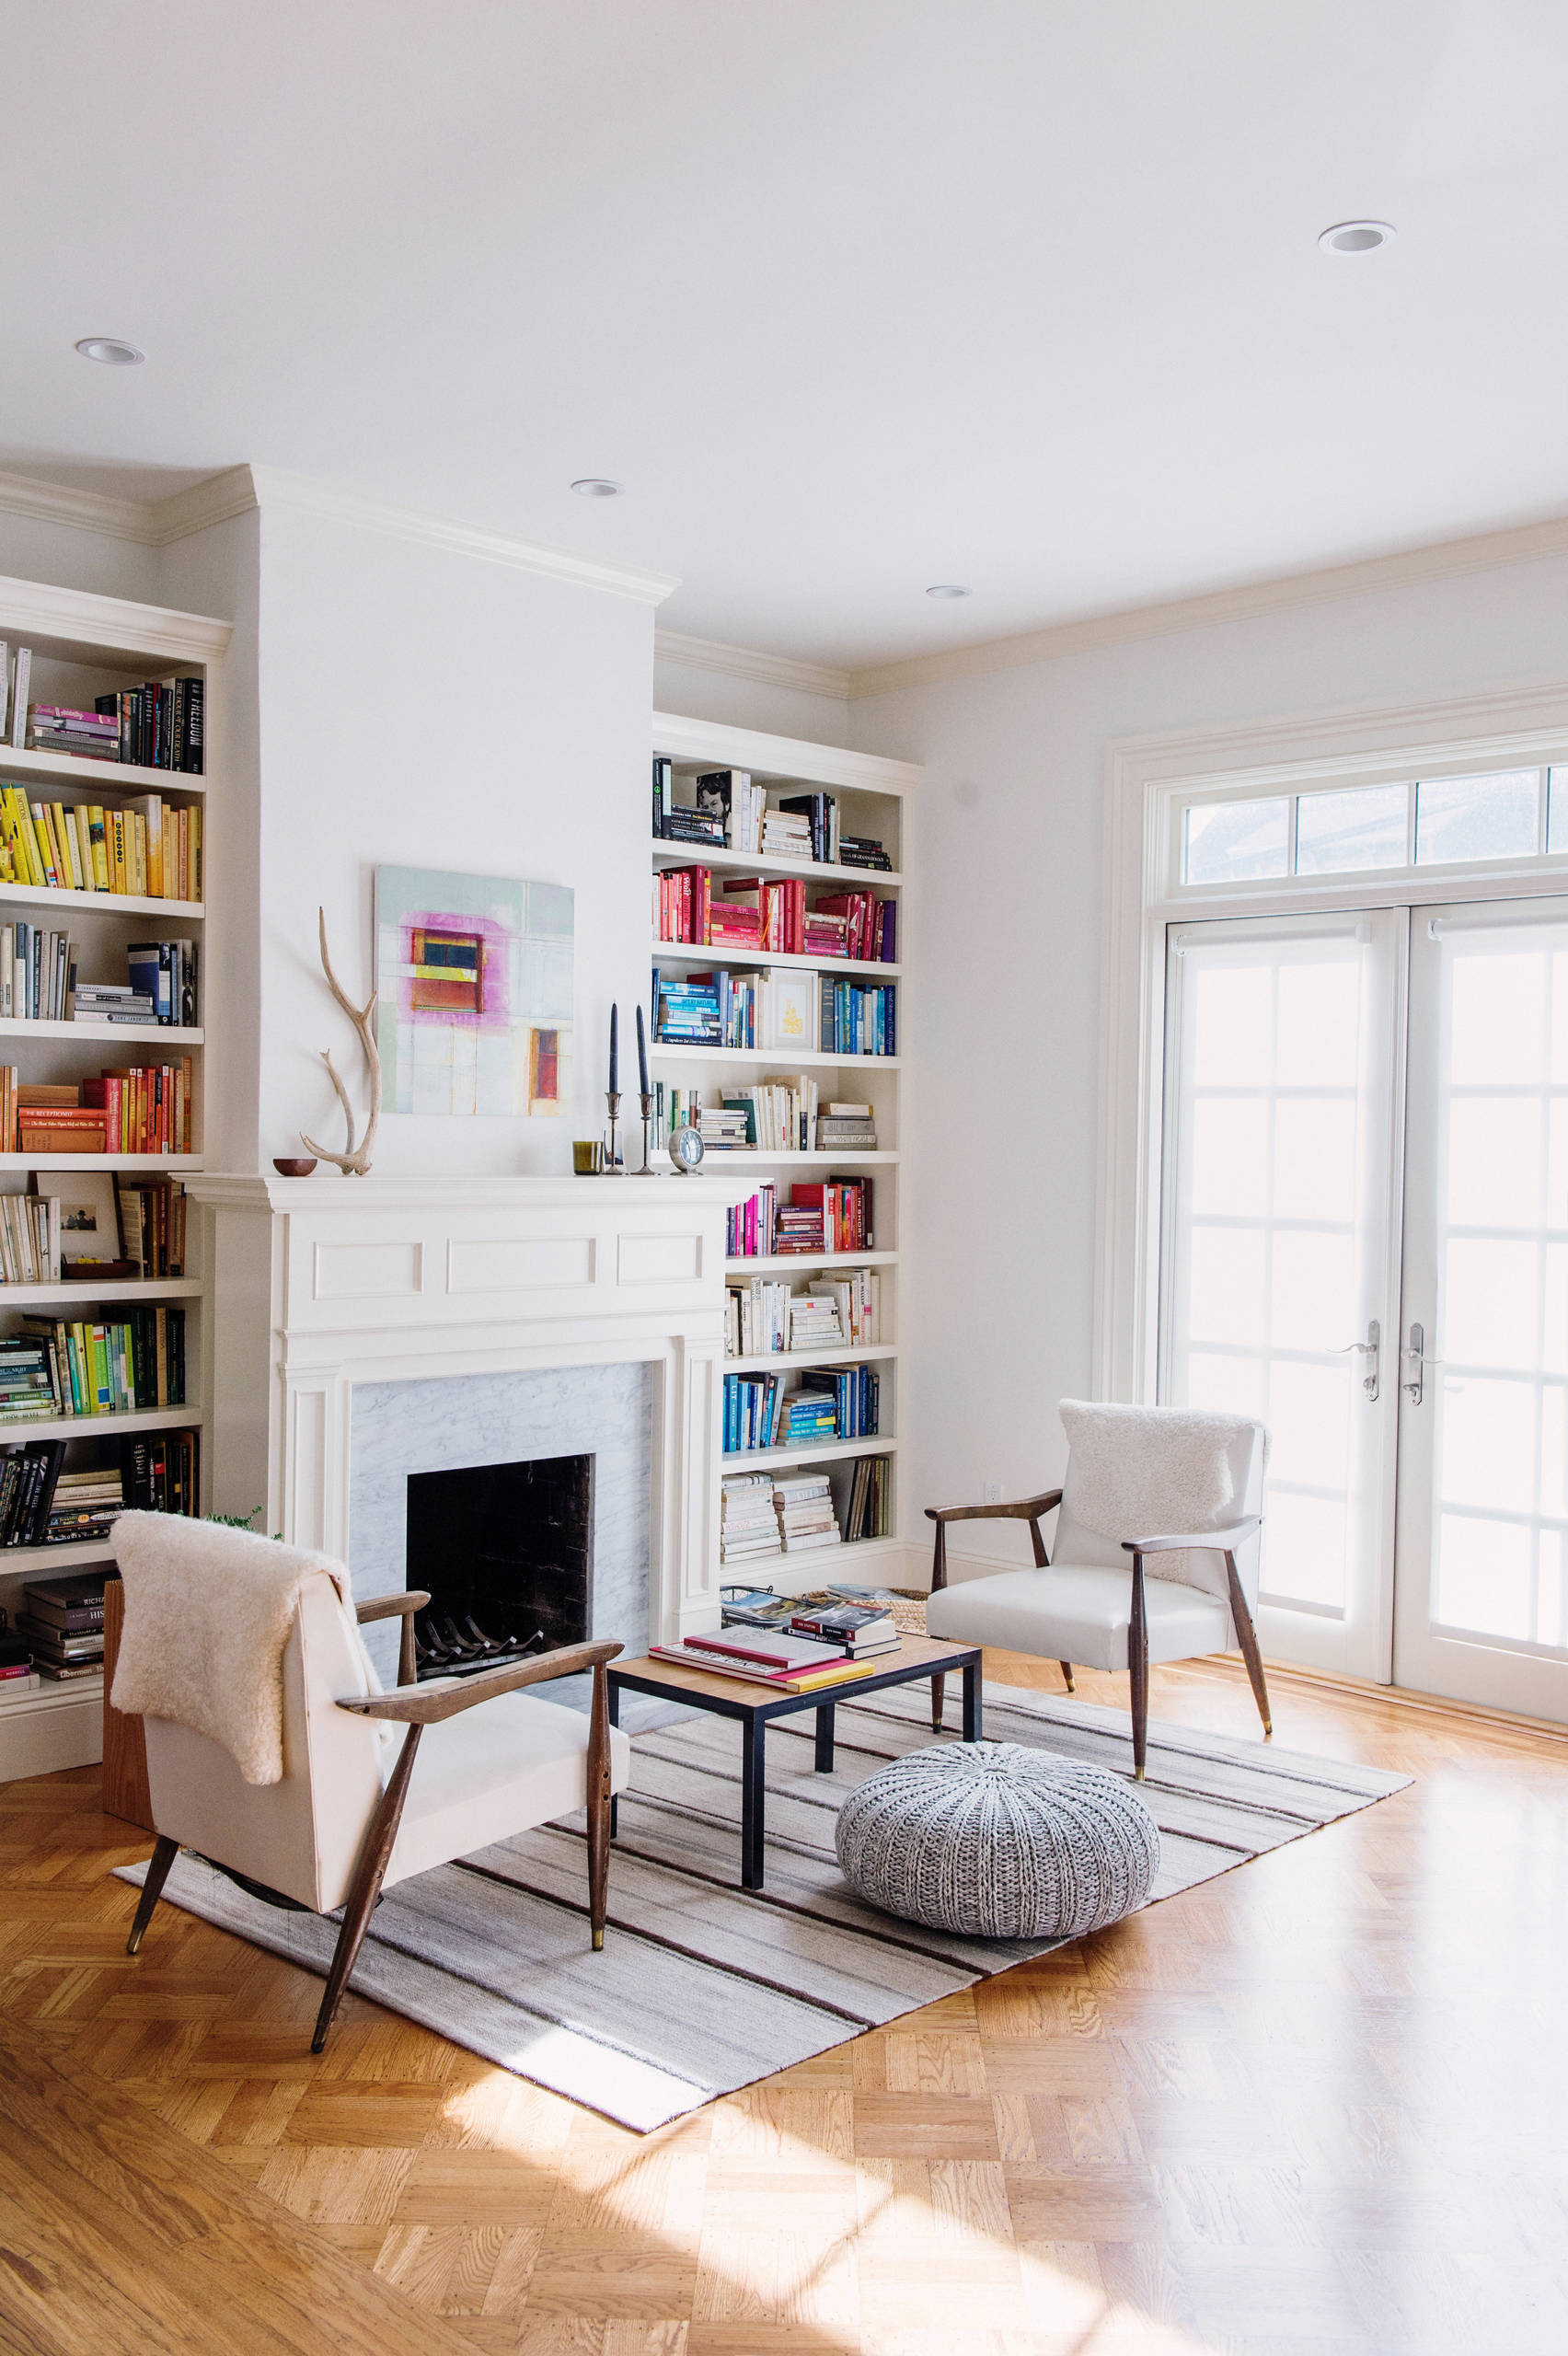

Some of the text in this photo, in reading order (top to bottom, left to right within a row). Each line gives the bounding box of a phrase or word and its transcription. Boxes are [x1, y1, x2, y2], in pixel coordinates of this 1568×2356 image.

[190, 699, 202, 745] FREEDOM
[858, 1197, 861, 1206] IN
[60, 1669, 93, 1678] Liberman
